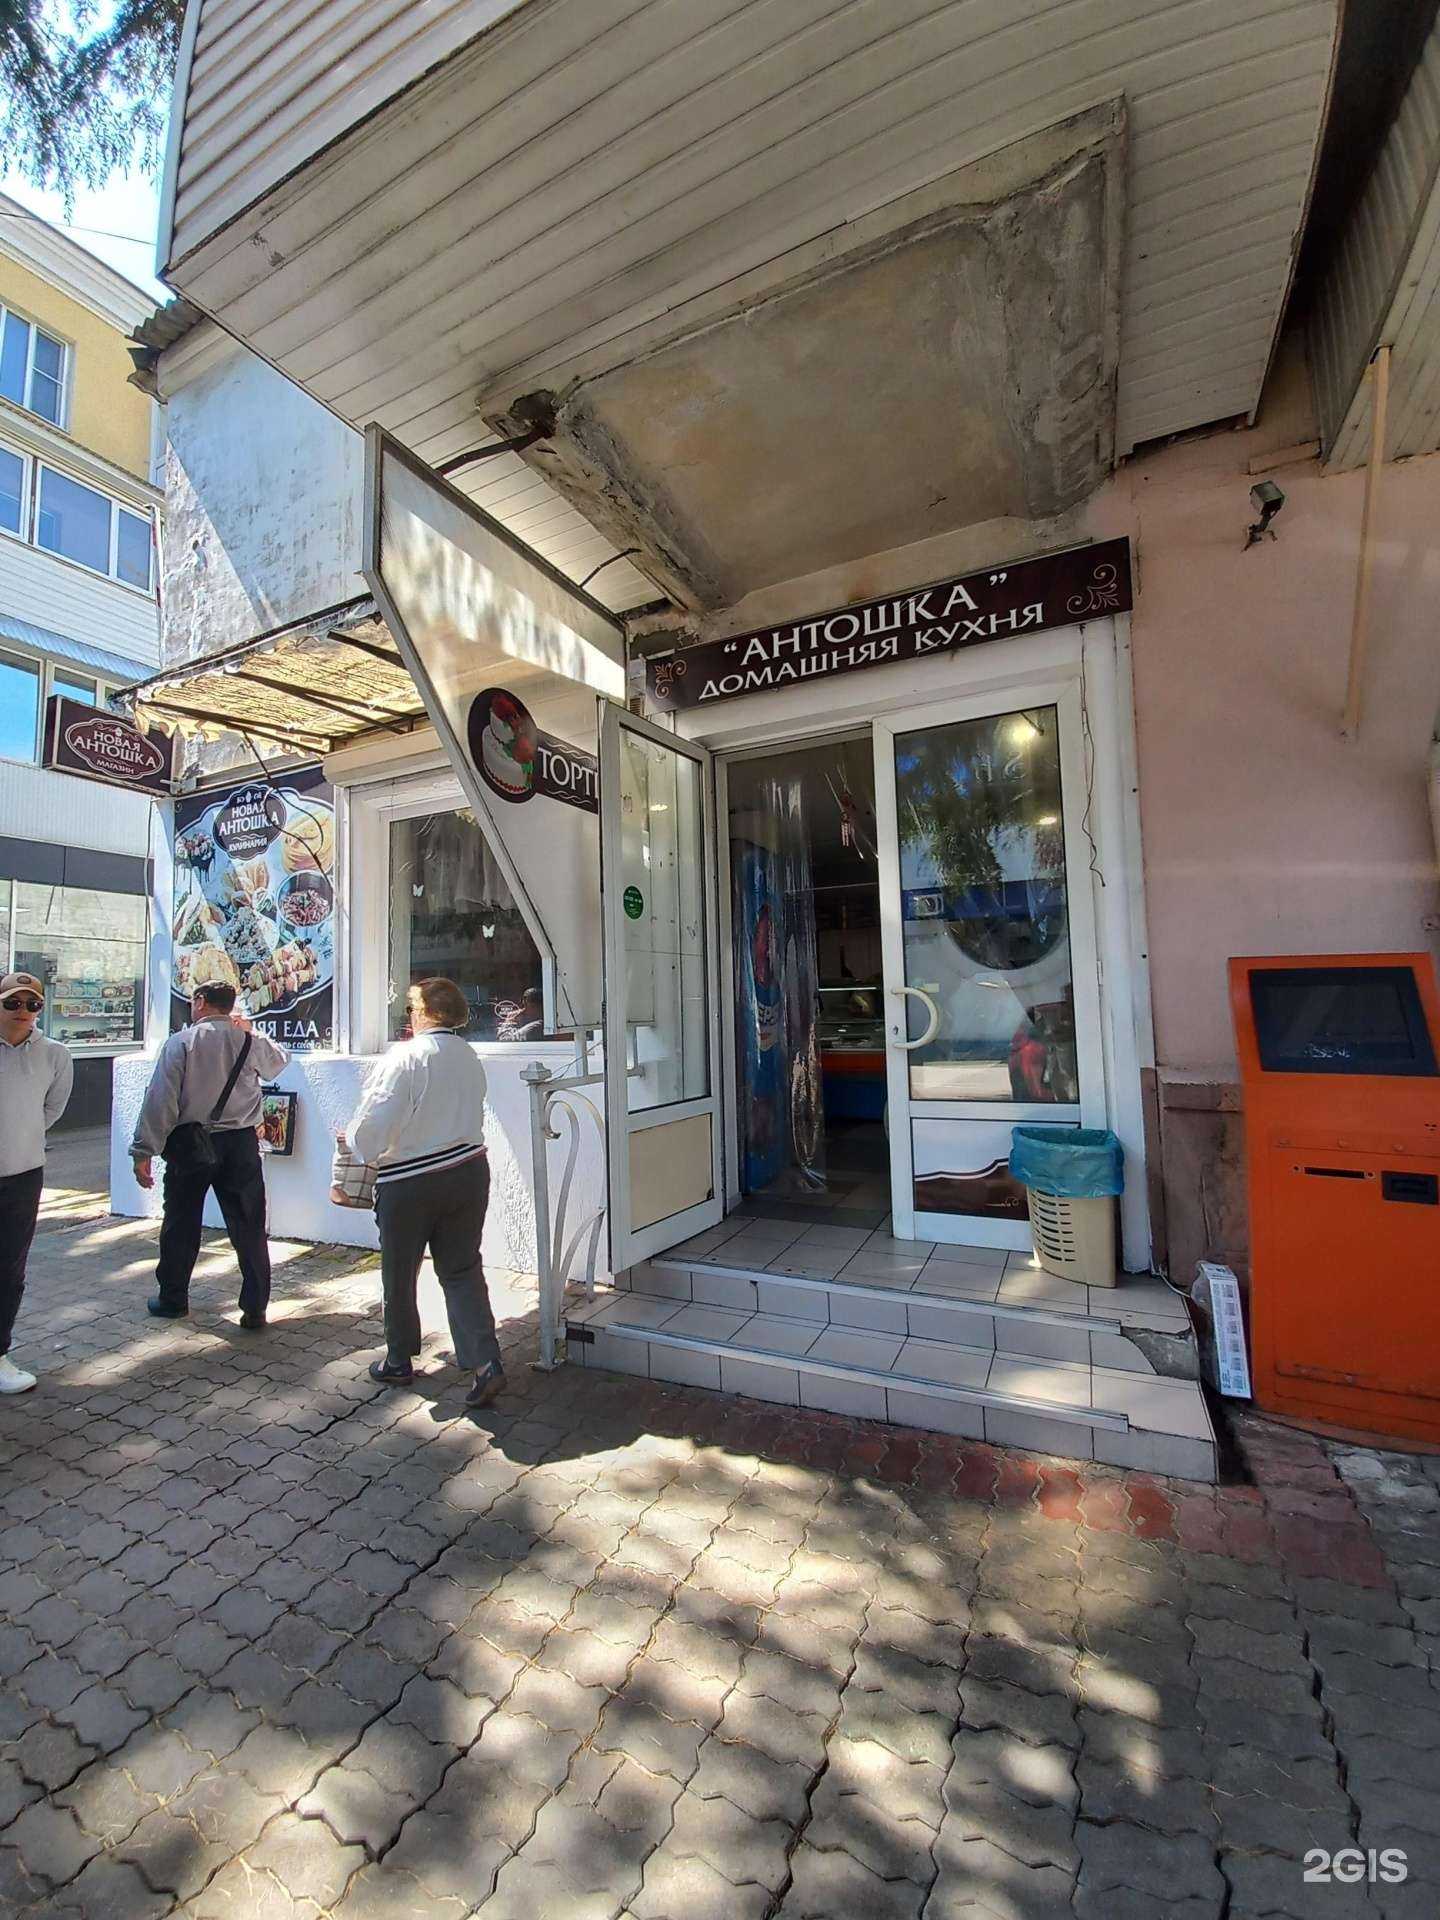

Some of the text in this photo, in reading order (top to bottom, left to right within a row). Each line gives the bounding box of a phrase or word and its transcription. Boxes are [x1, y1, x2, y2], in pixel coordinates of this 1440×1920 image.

[699, 602, 1044, 700] ДОМАШНЯЯ КУХНЯ
[73, 735, 156, 768] АНТОШКА
[93, 731, 140, 752] НОВАЯ
[97, 759, 134, 774] МАГАЗИН
[232, 801, 266, 818] НОВАЯ
[219, 811, 279, 836] АНТОШКА
[284, 1020, 319, 1038] ЕДА
